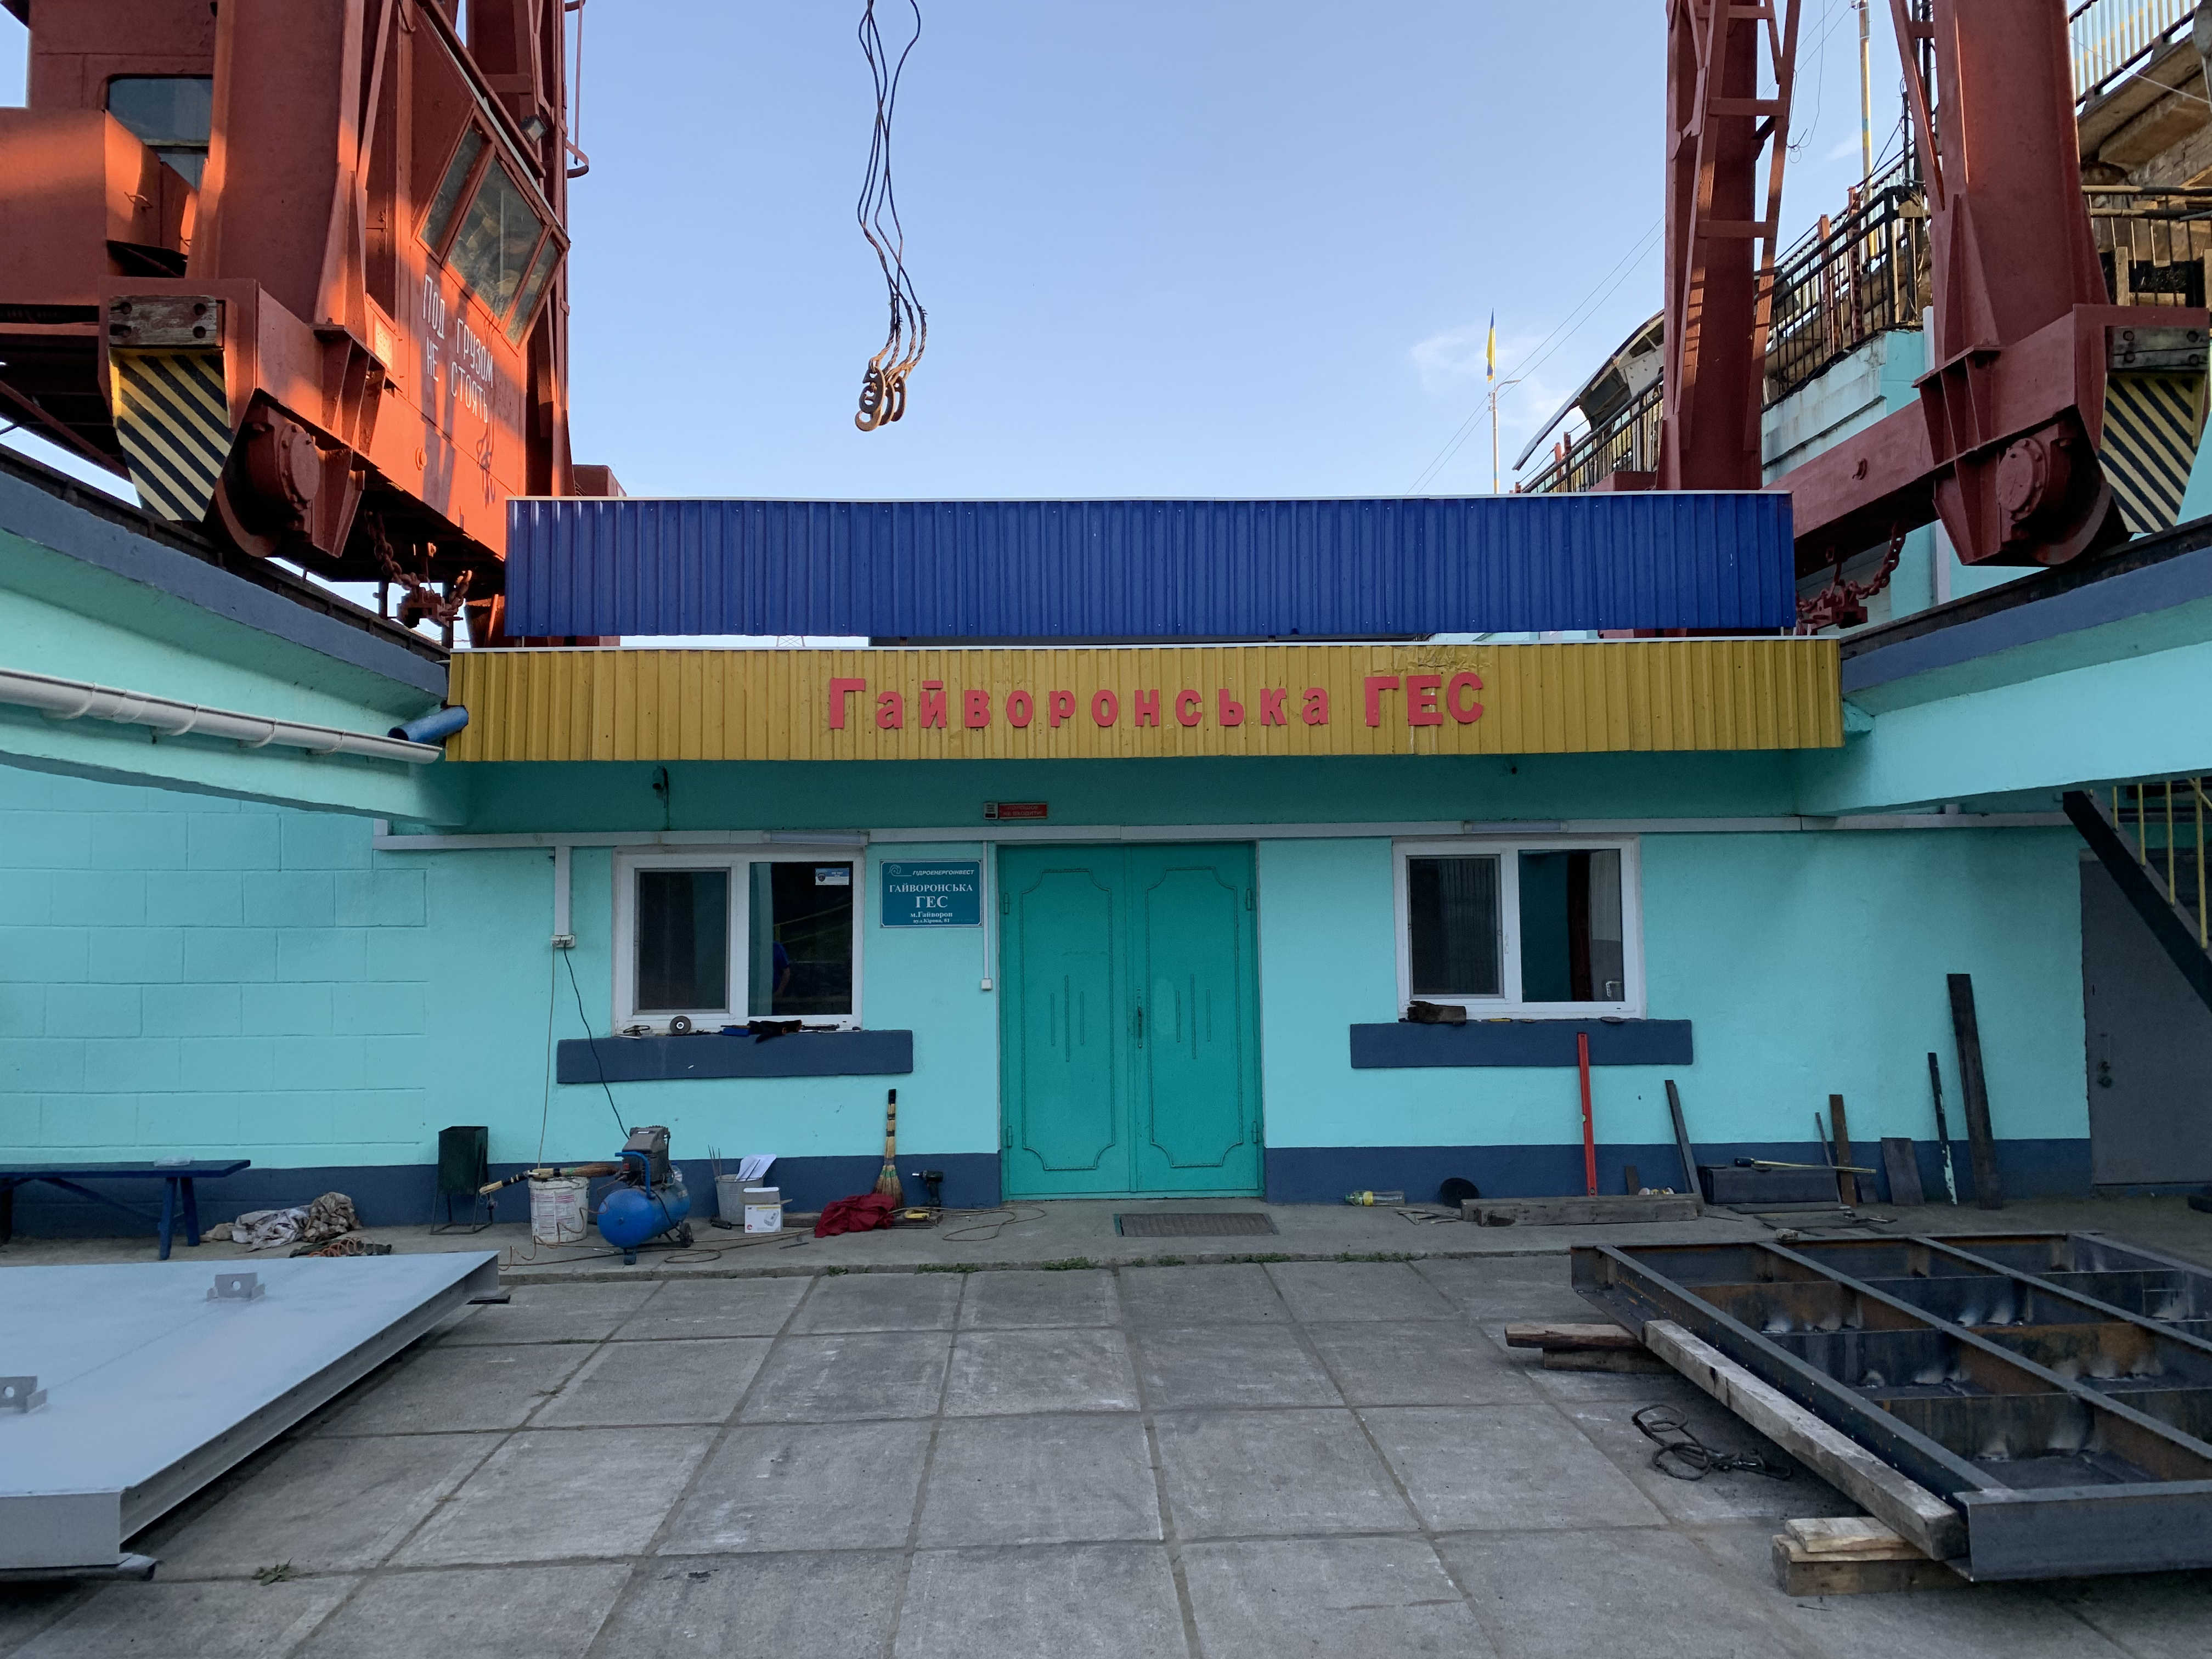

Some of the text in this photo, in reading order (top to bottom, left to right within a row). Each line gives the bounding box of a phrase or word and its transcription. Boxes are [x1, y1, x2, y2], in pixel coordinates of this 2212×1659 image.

[422, 274, 493, 388] ПОД ГРУЗОМ
[426, 336, 439, 382] НЕ
[450, 361, 488, 424] СТОЯТЬ
[829, 672, 1484, 730] Гайворонська ГЕС
[889, 882, 973, 893] ГАЙВОРОНСЬКА
[915, 895, 949, 908] ГЕС
